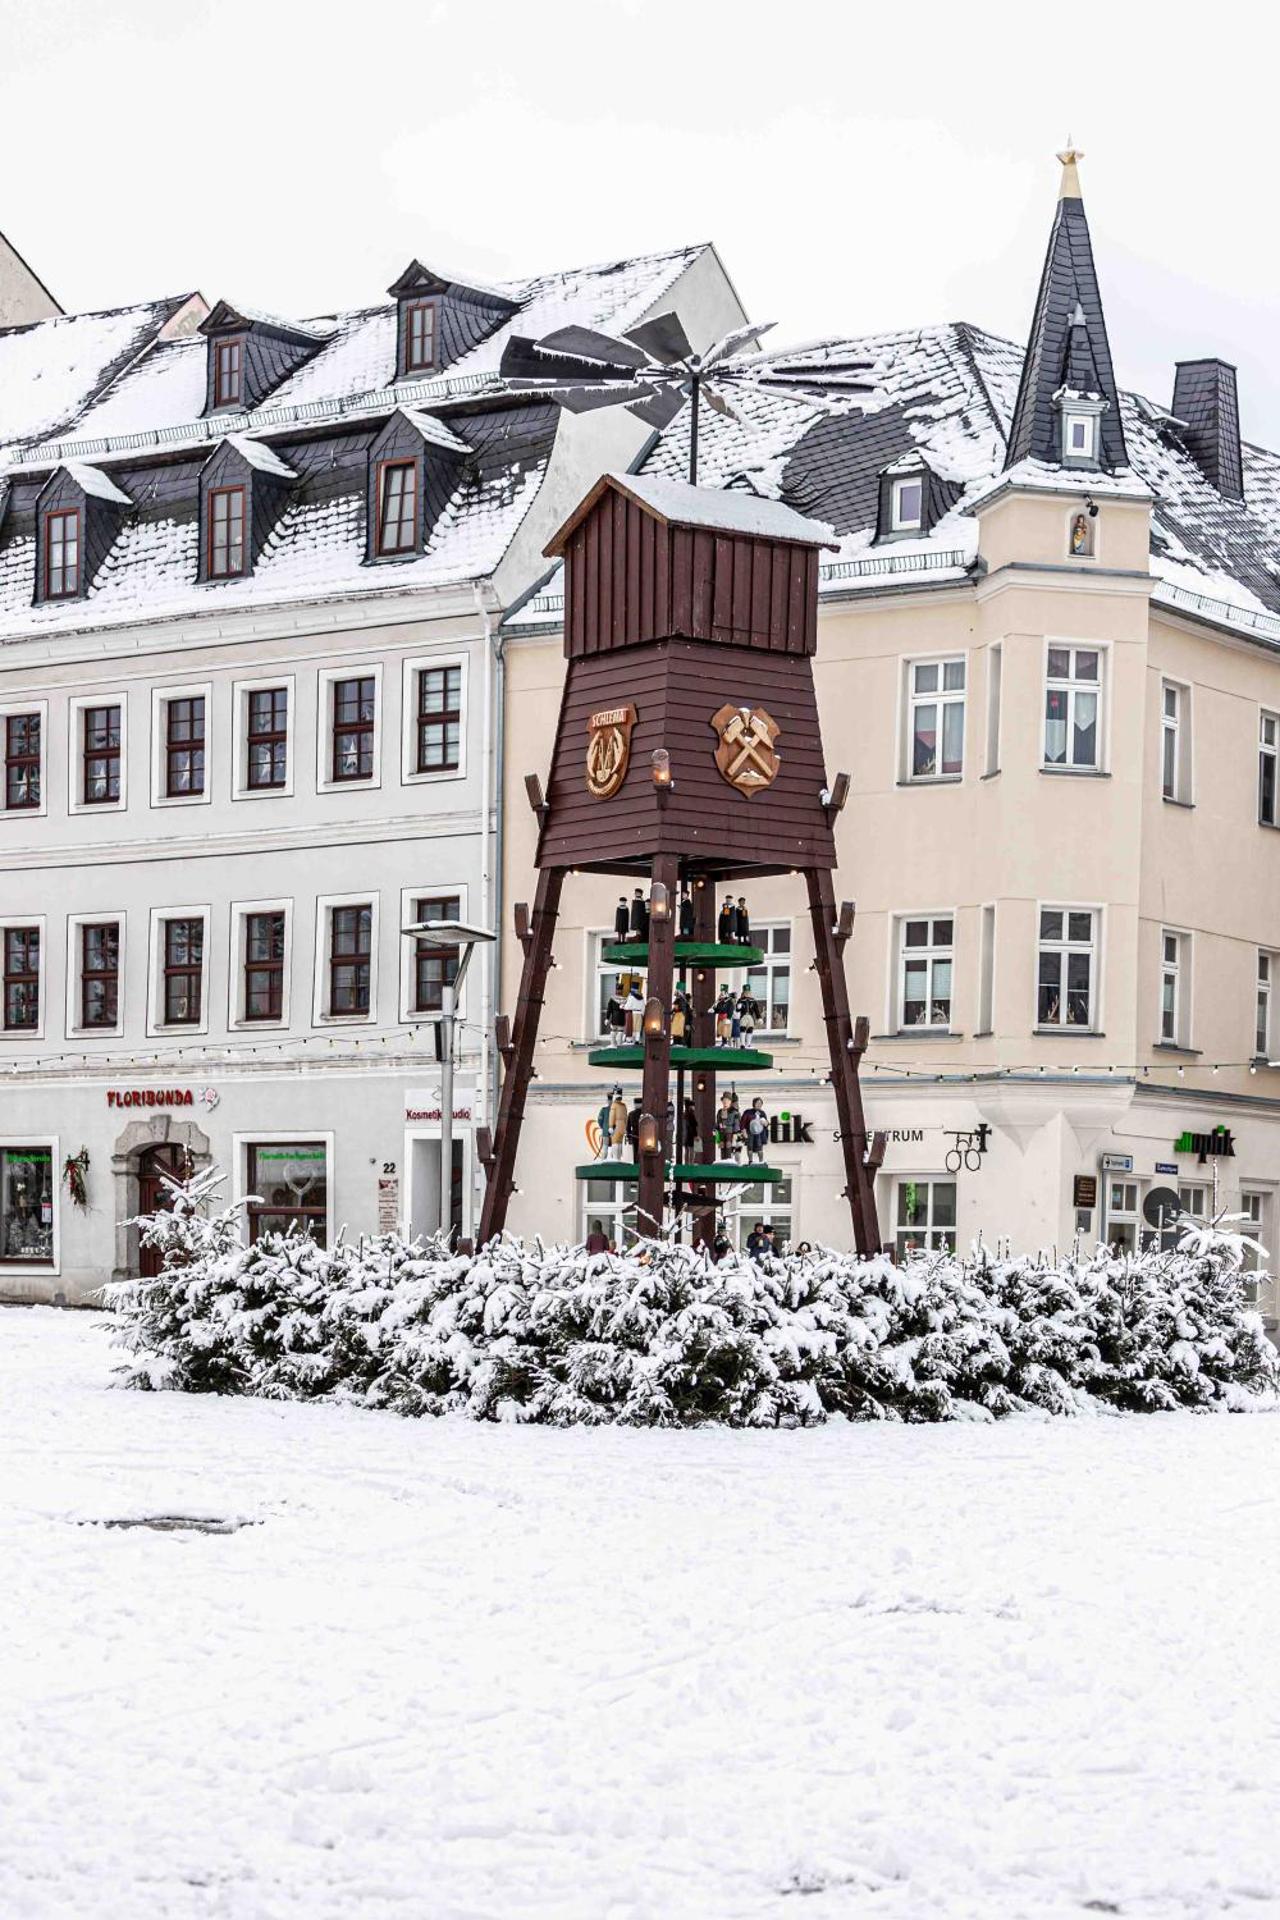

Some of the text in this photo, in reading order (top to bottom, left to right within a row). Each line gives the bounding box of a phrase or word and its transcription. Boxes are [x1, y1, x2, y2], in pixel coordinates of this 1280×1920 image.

[107, 1089, 194, 1108] FLORIBUNDA
[771, 1112, 815, 1144] tik
[383, 1162, 396, 1174] 22
